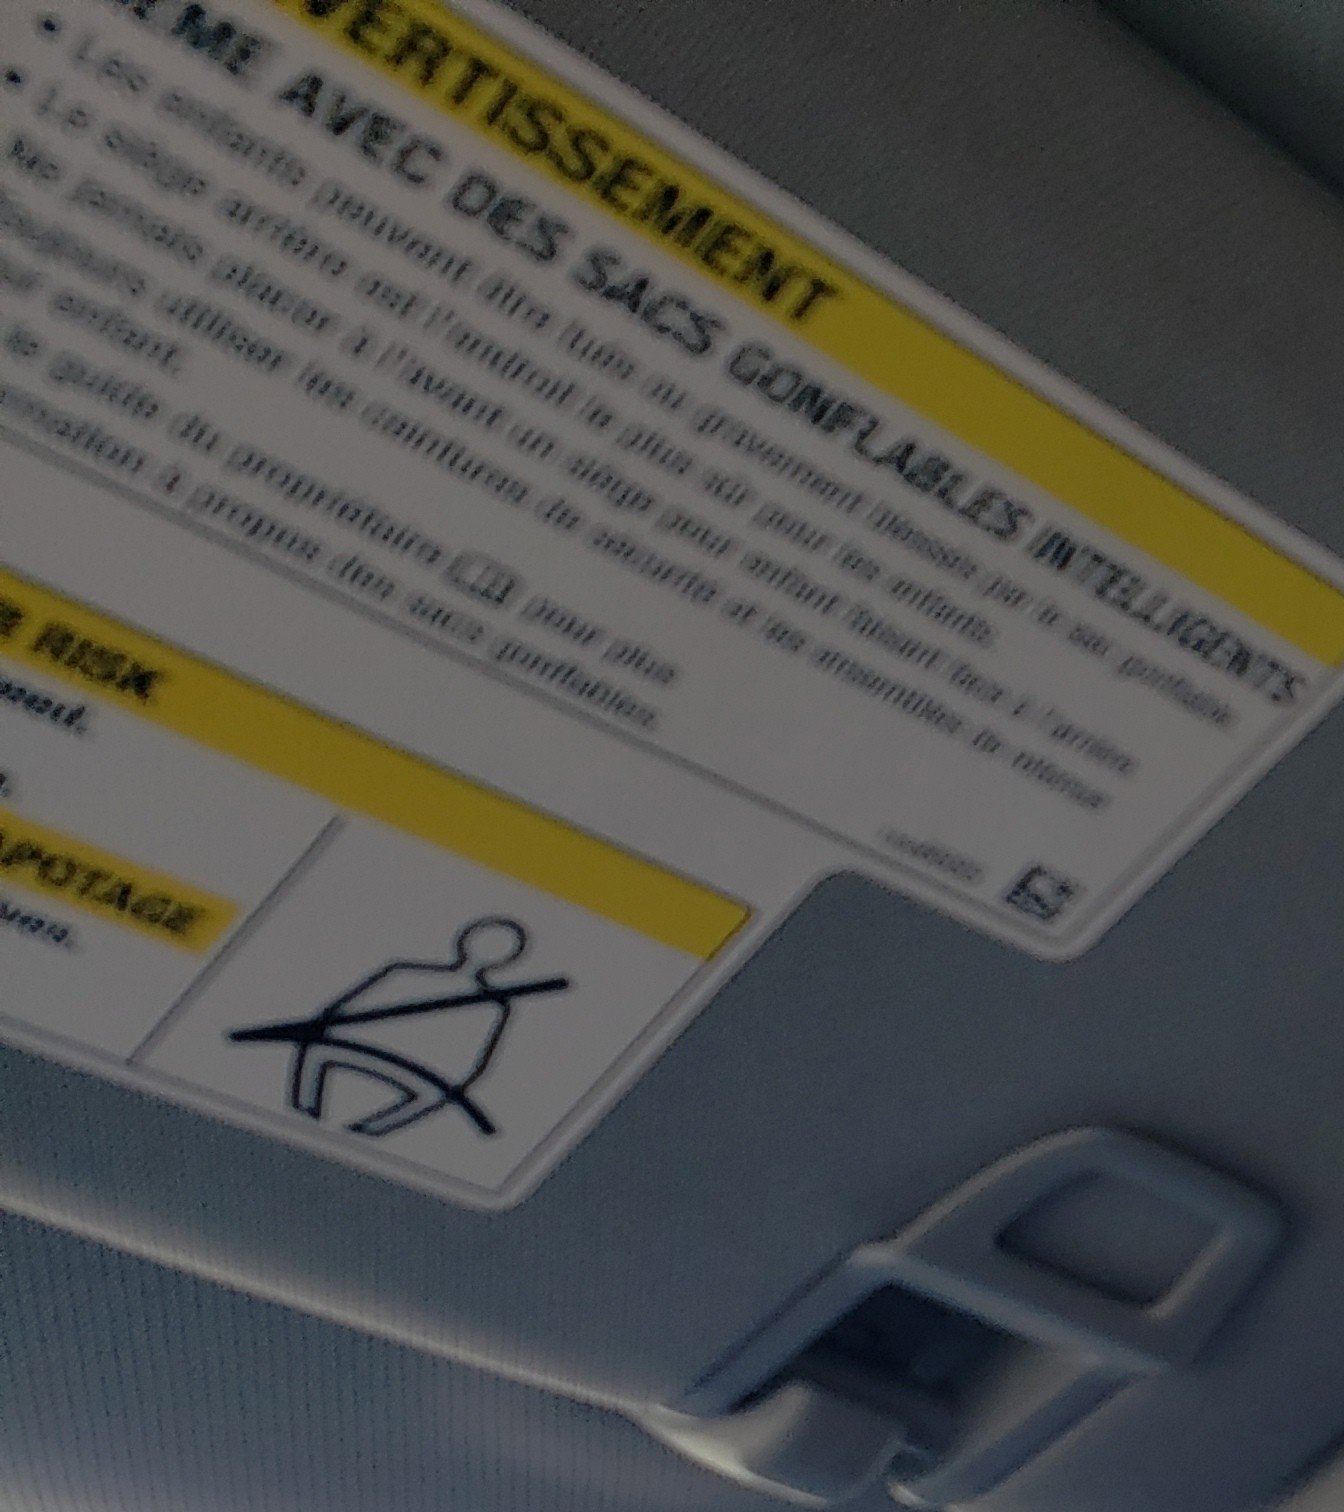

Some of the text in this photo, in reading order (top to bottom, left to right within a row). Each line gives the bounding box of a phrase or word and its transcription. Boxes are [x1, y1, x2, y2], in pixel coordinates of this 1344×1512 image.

[275, 70, 445, 187] AVEC
[445, 169, 573, 265] DES
[570, 247, 725, 358] SACS
[725, 342, 1032, 542] GONFLABLES
[1025, 527, 1304, 704] INTELLIGENTS
[0, 830, 203, 934] POTAGE
